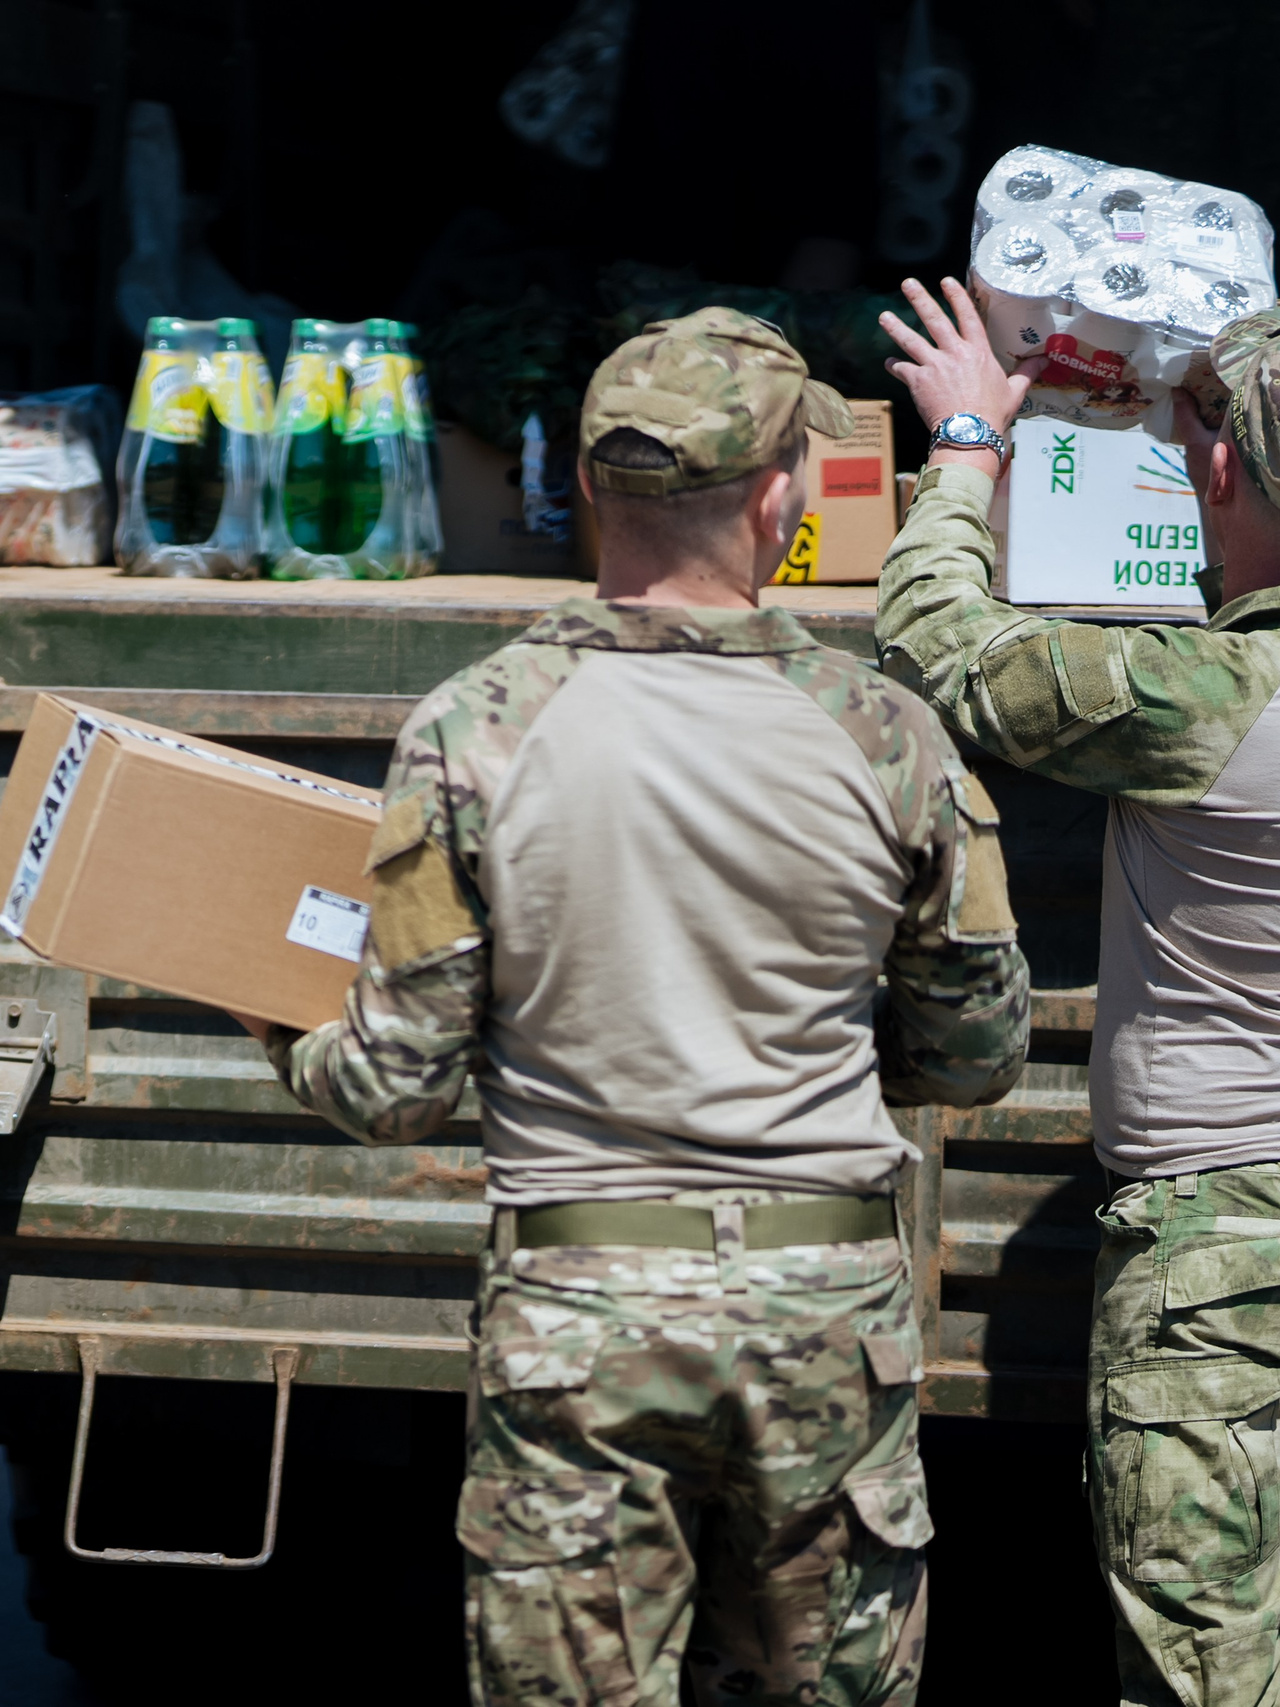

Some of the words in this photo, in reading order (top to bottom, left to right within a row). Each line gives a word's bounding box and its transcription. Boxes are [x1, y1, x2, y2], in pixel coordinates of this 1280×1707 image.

[1048, 350, 1118, 380] НОВИНКА
[1051, 432, 1076, 494] ZDK
[1126, 523, 1198, 550] БЕЛЬ
[299, 913, 318, 931] 10
